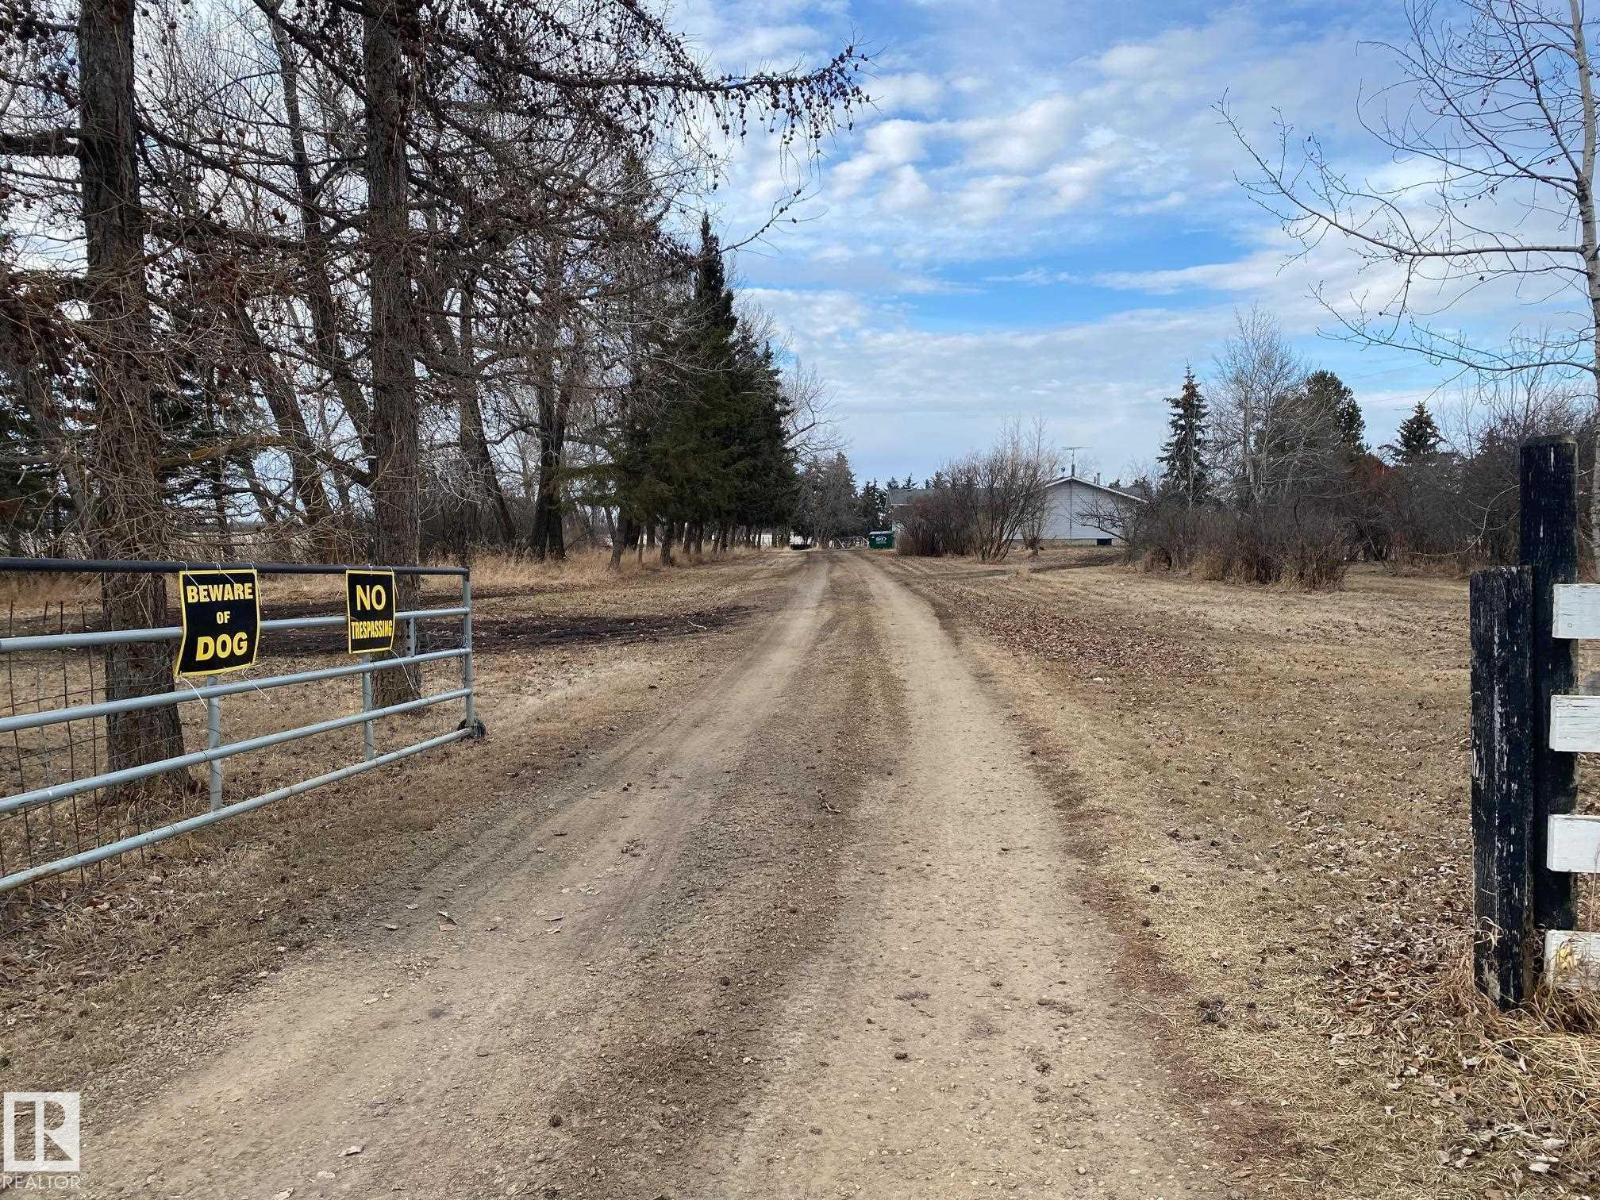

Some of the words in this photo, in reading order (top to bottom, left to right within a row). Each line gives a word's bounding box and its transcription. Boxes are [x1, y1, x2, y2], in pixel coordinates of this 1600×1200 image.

[186, 583, 254, 603] BEWARE
[356, 585, 386, 611] NO
[216, 611, 231, 625] OF
[351, 620, 393, 640] TRESPASSING
[195, 632, 248, 661] DOG
